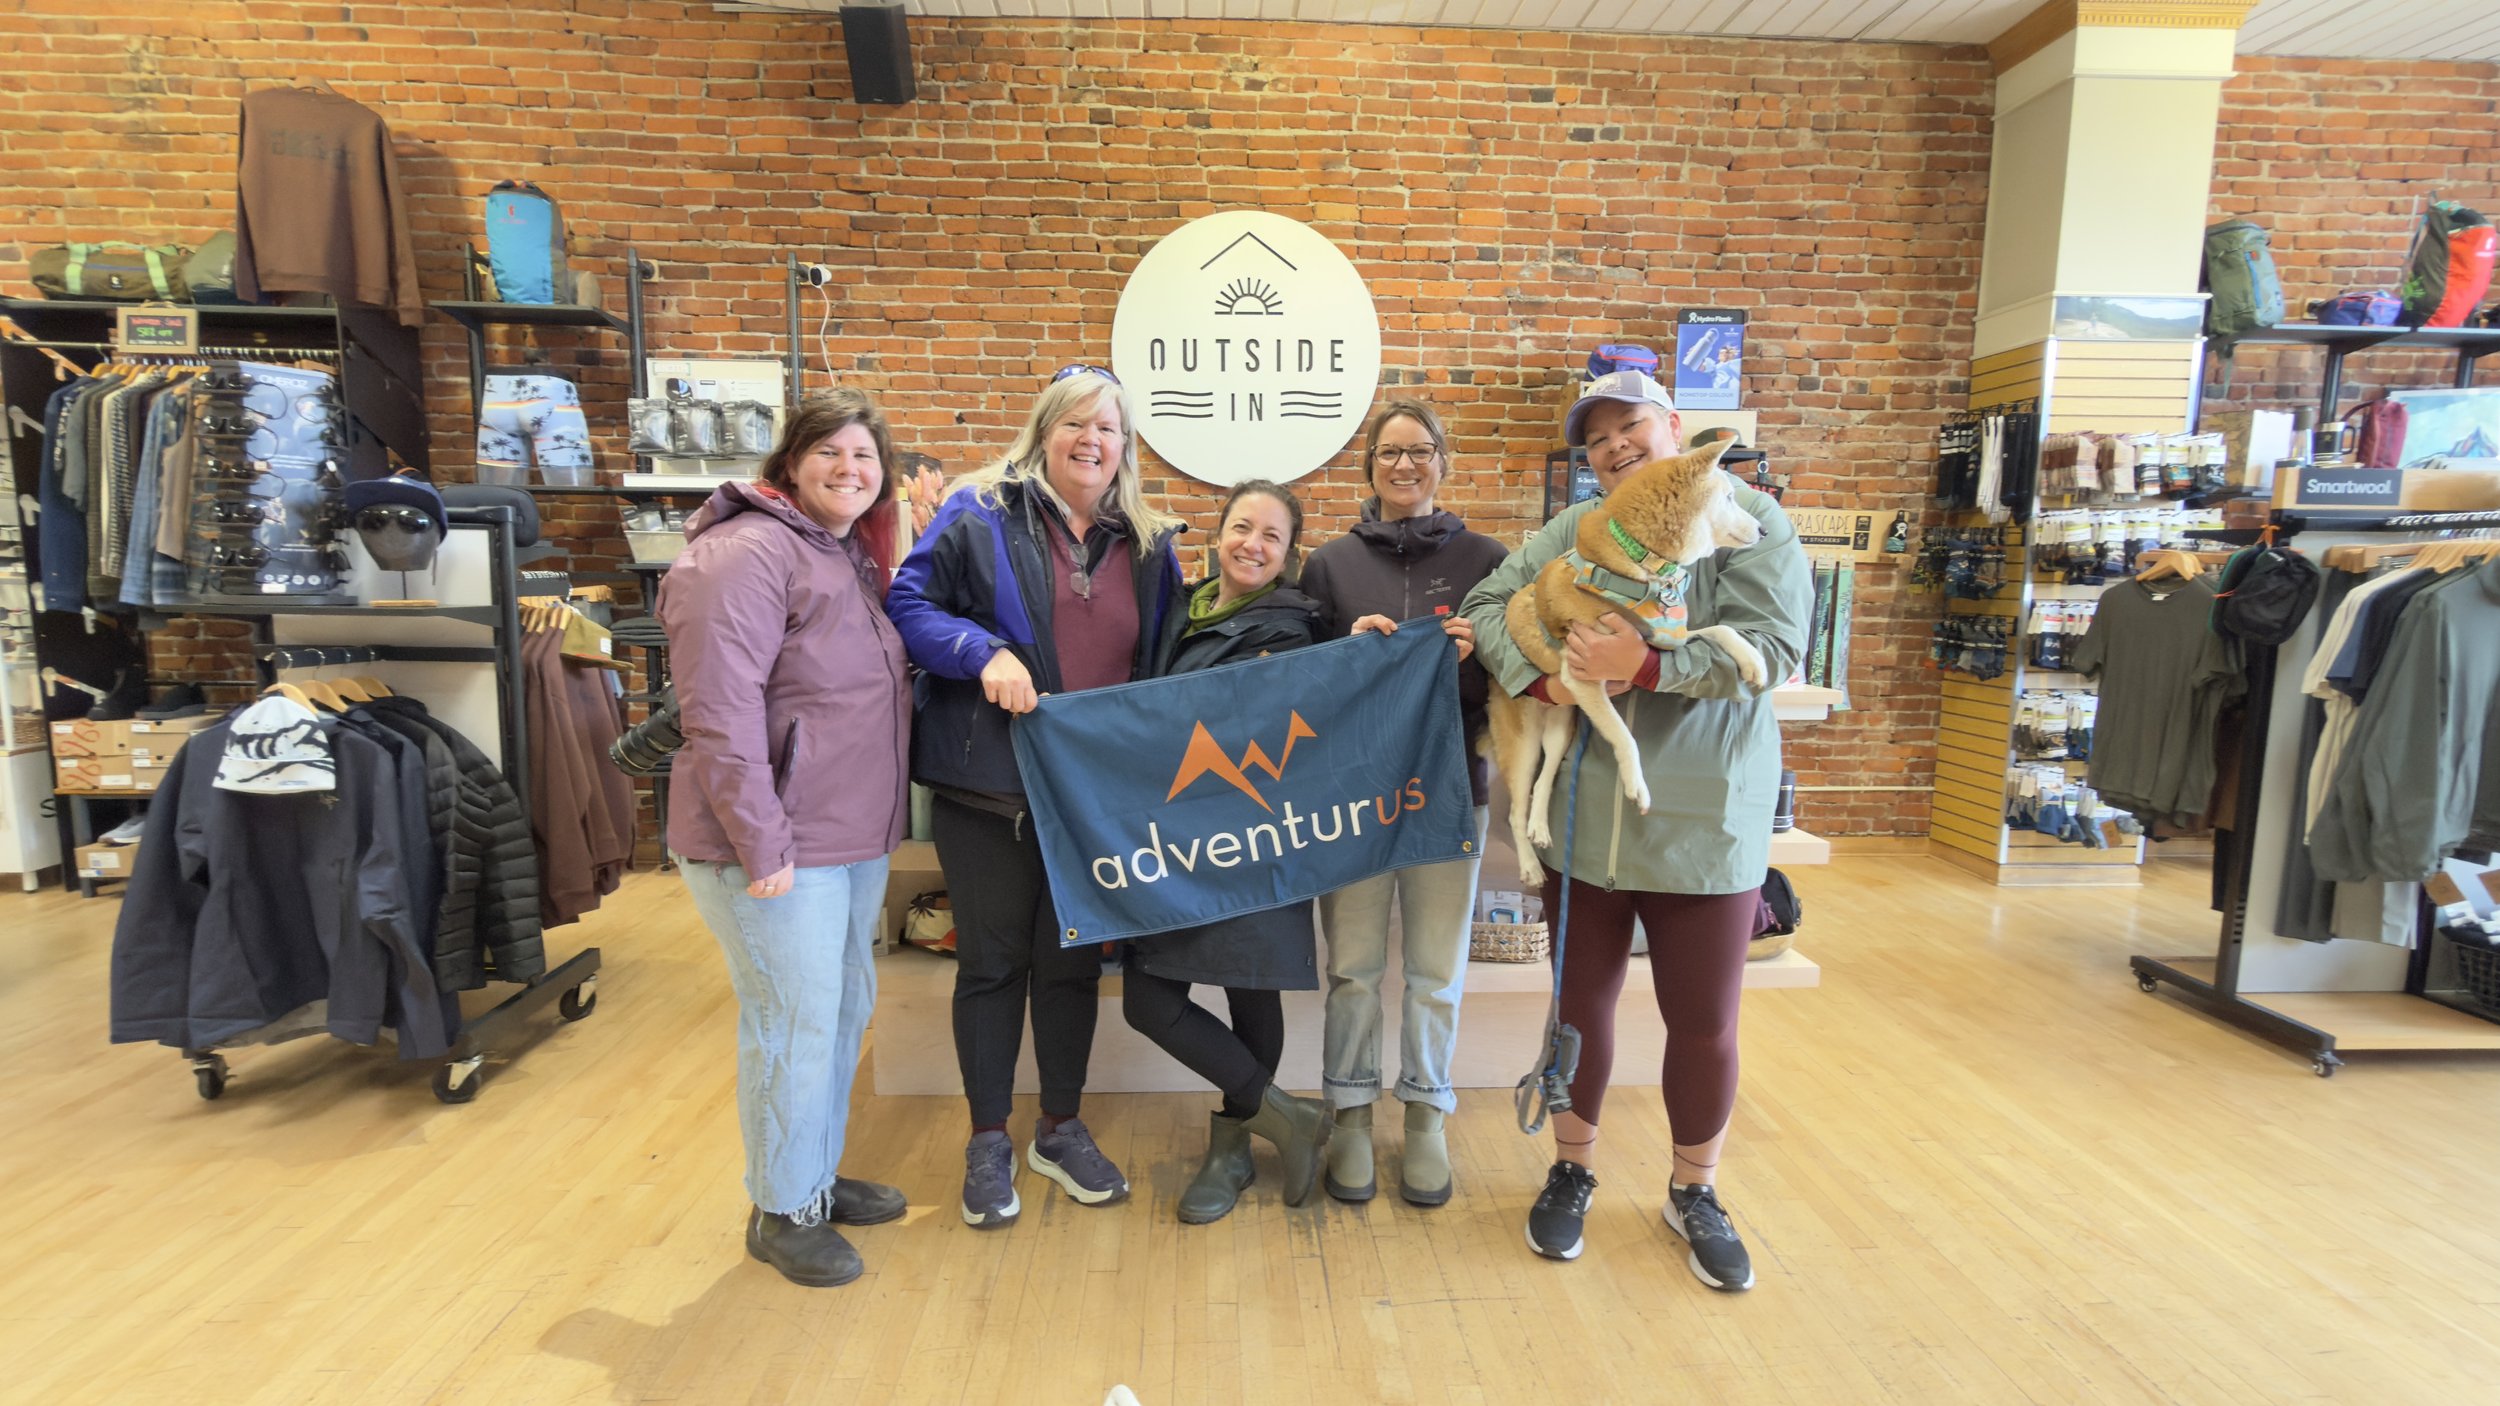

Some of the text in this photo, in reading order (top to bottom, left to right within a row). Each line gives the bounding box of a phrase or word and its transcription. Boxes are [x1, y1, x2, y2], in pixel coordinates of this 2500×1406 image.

[1150, 338, 1344, 372] OUTSIDE
[1231, 393, 1263, 421] IN
[1092, 777, 1426, 889] adventurus
